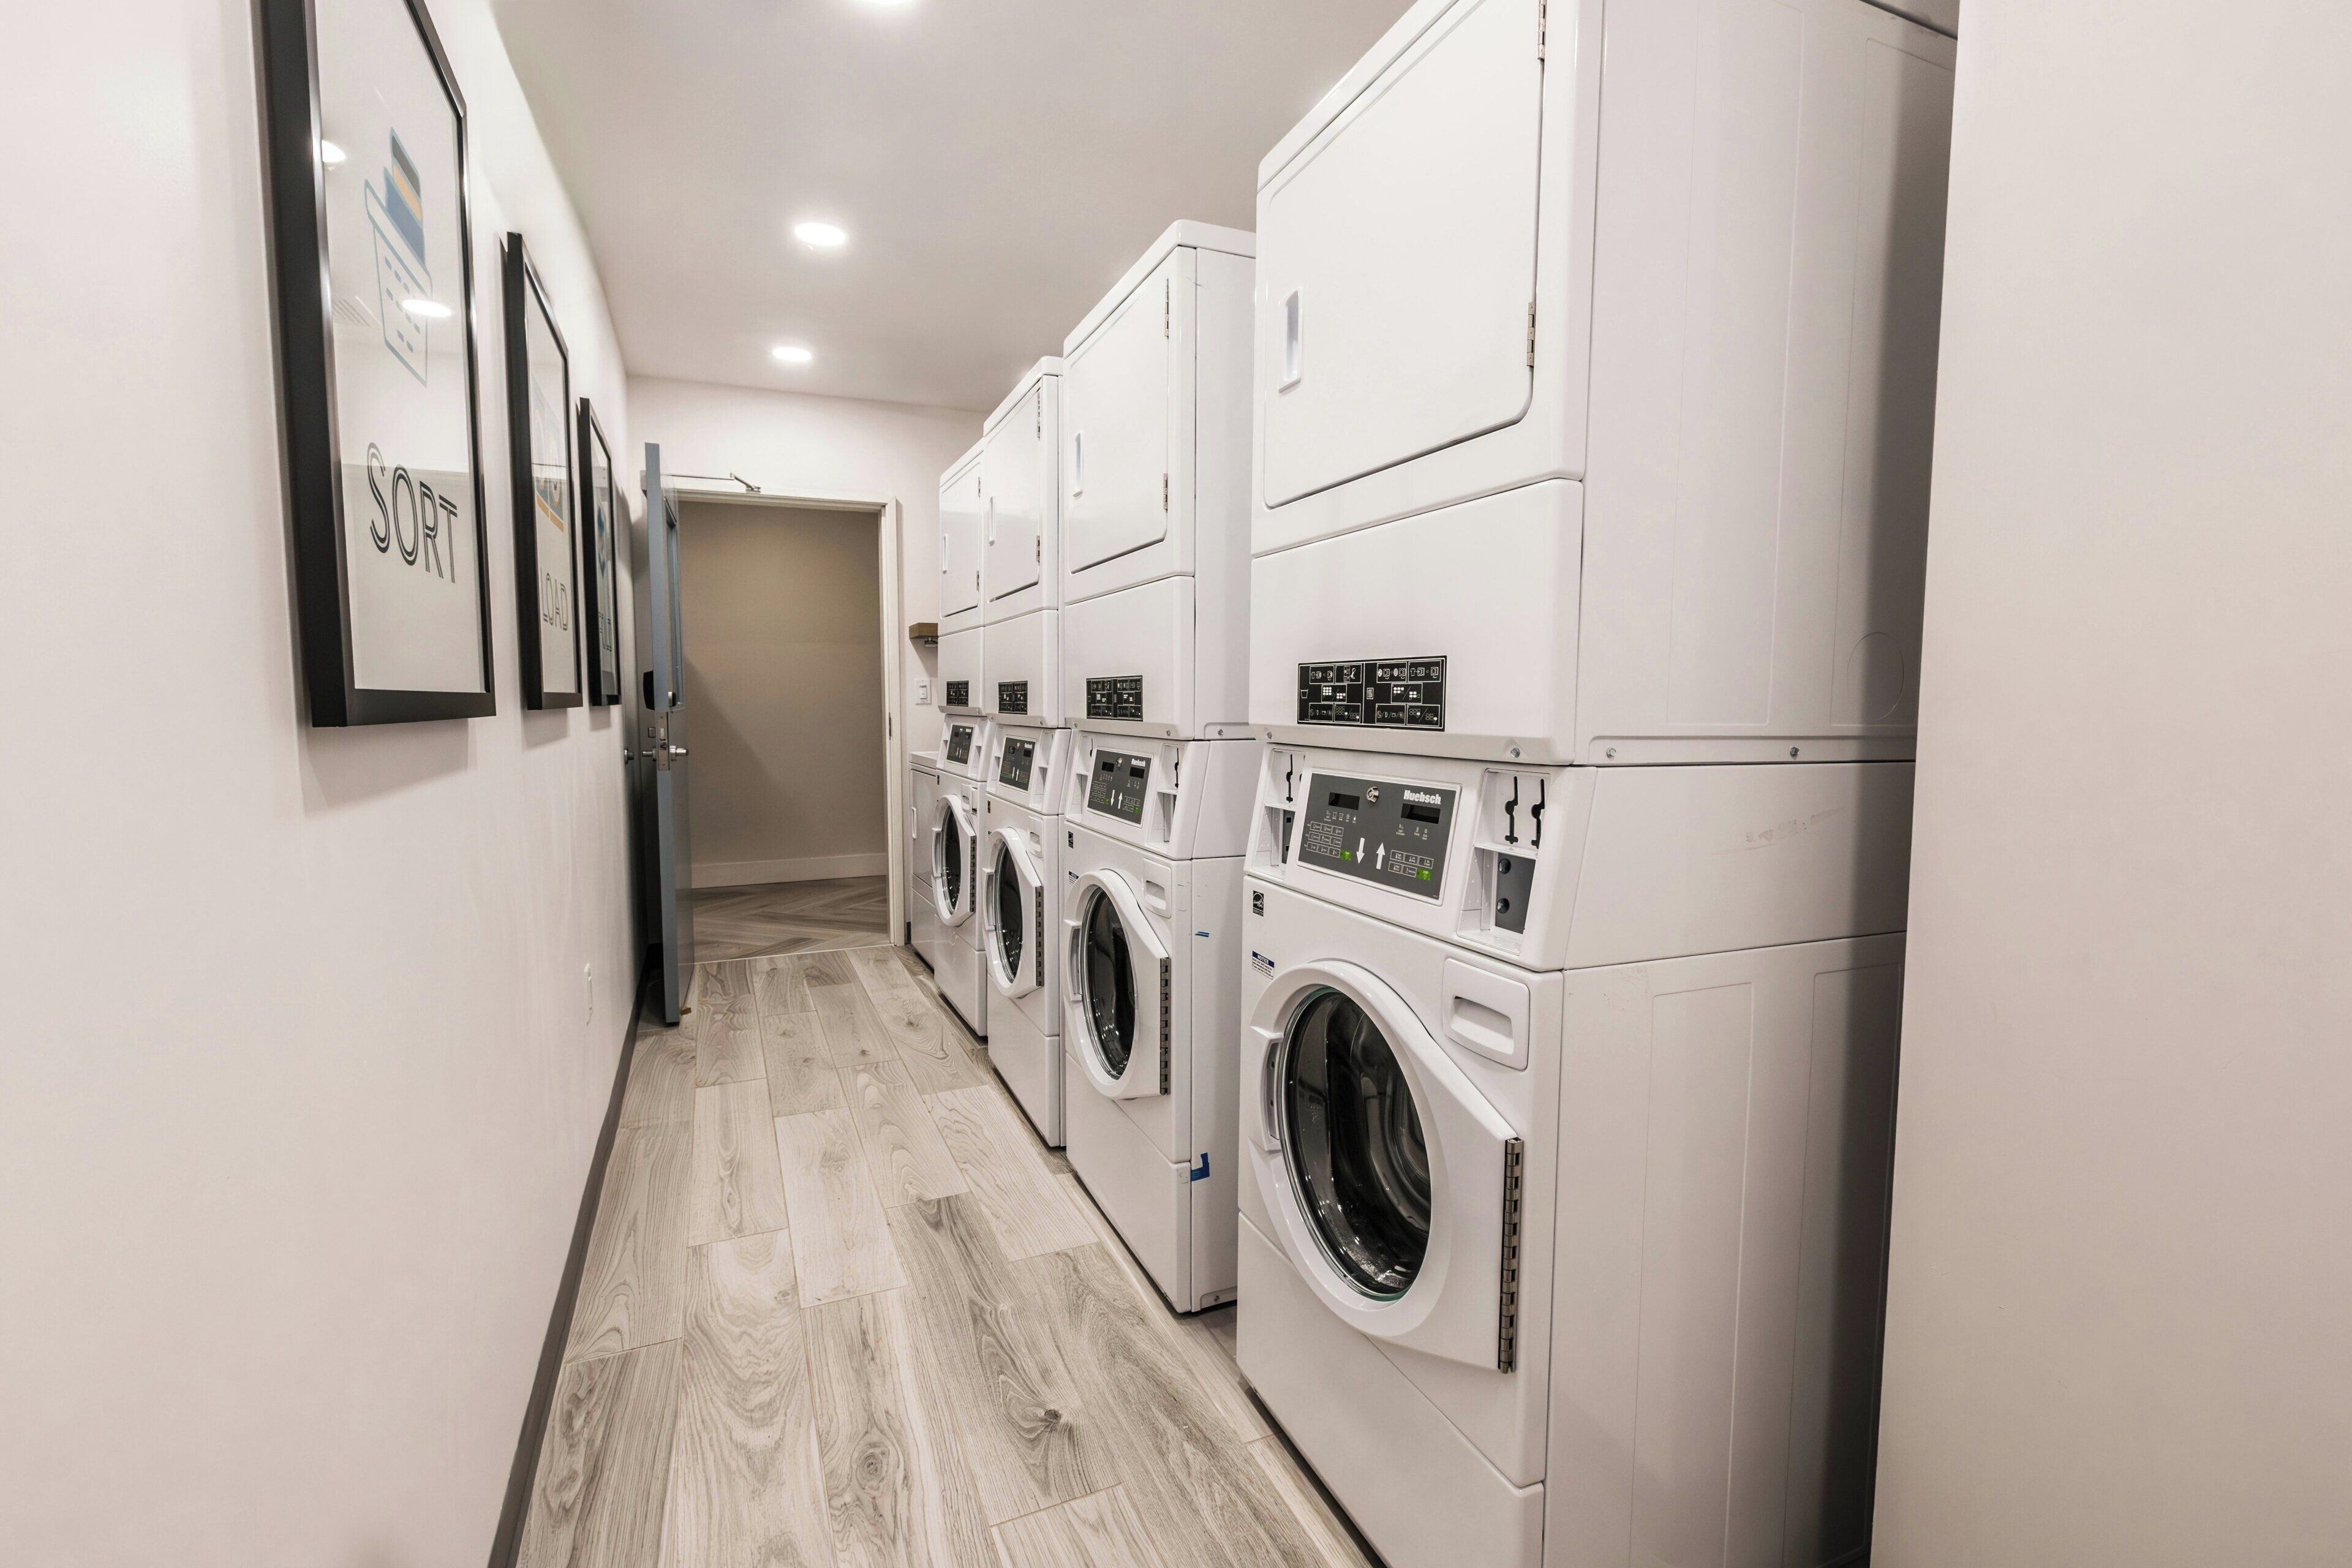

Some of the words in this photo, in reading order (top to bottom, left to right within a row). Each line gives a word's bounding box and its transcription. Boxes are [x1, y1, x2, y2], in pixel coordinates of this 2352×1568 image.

[368, 442, 458, 584] SORT
[540, 567, 568, 631] LOAD
[1403, 790, 1442, 804] Huebsch
[1257, 954, 1269, 965] NOTICE
